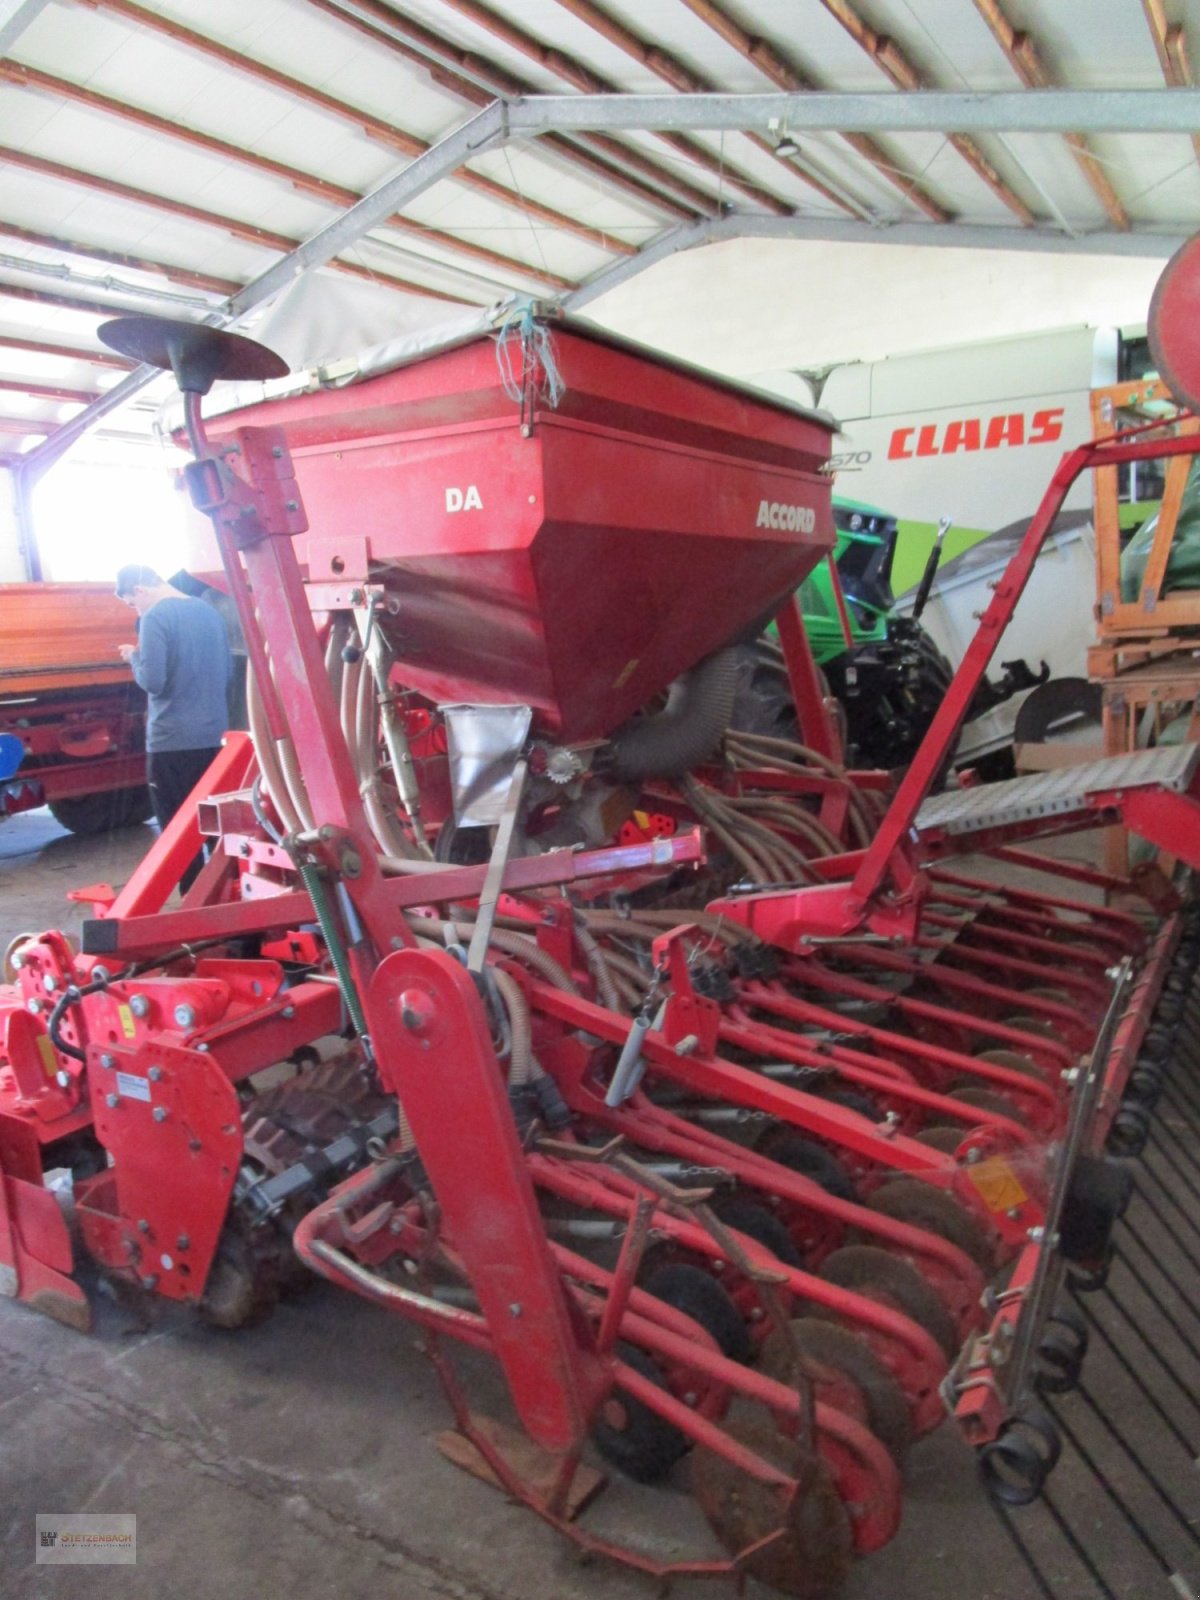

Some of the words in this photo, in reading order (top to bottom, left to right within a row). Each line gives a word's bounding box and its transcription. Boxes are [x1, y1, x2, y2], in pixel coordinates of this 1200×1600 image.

[887, 408, 1065, 461] CLAAS
[445, 485, 484, 512] DA
[755, 500, 816, 534] ACCORD
